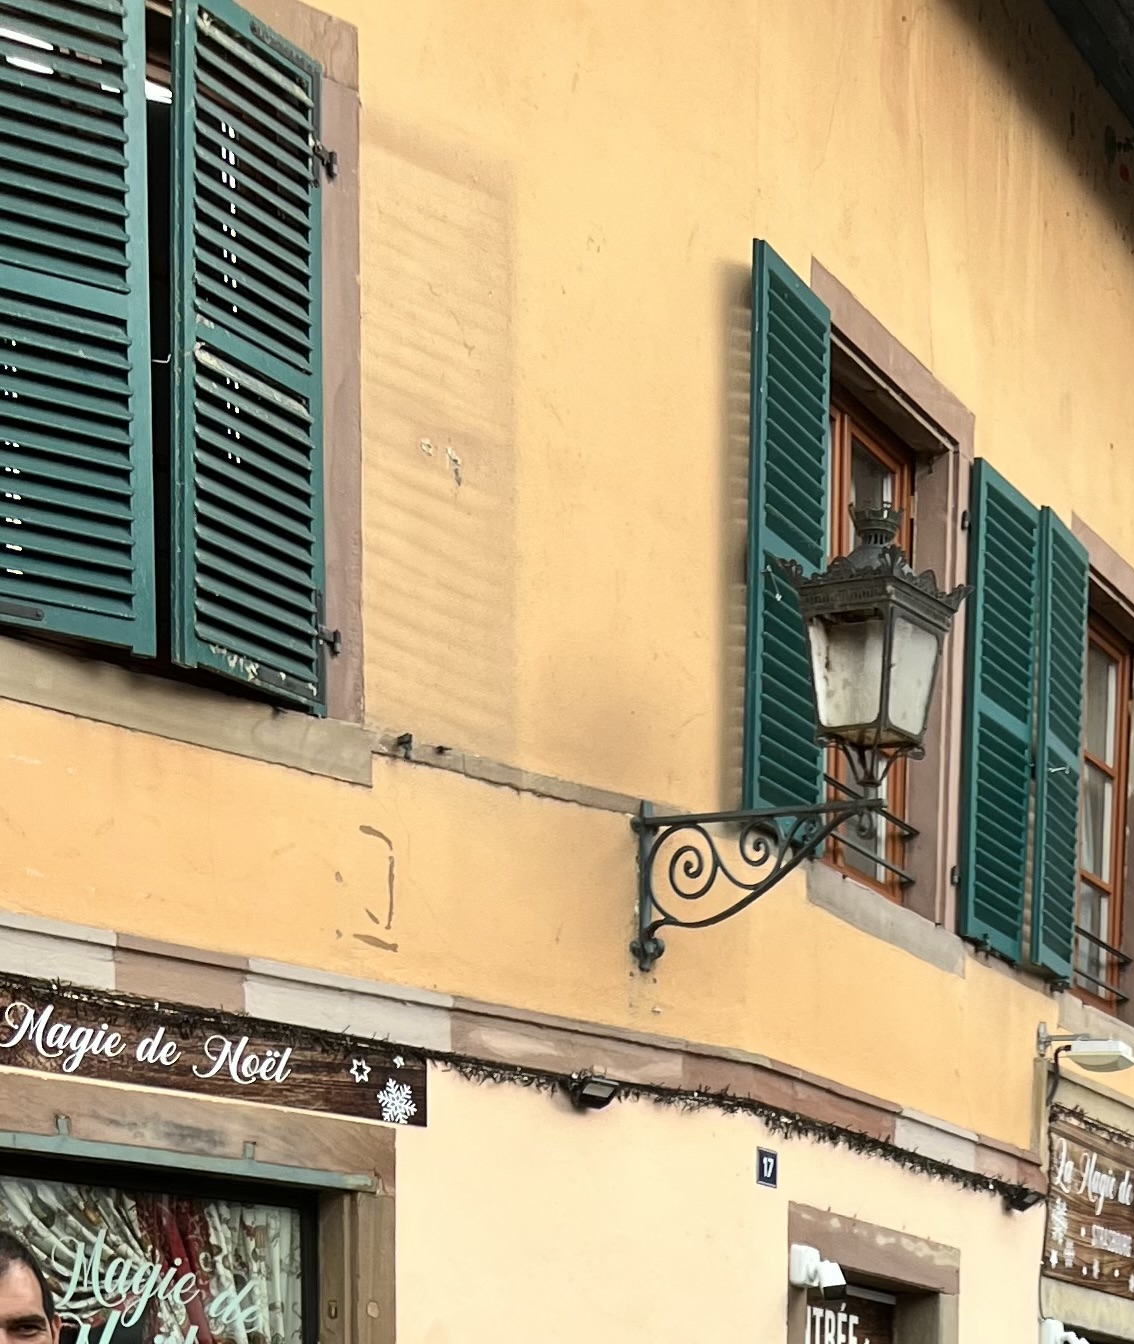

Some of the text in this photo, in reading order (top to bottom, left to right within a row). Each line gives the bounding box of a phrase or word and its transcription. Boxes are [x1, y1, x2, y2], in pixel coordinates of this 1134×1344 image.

[0, 1001, 293, 1084] Magie de Noël
[763, 1156, 774, 1178] 17
[51, 1229, 262, 1332] Magie de
